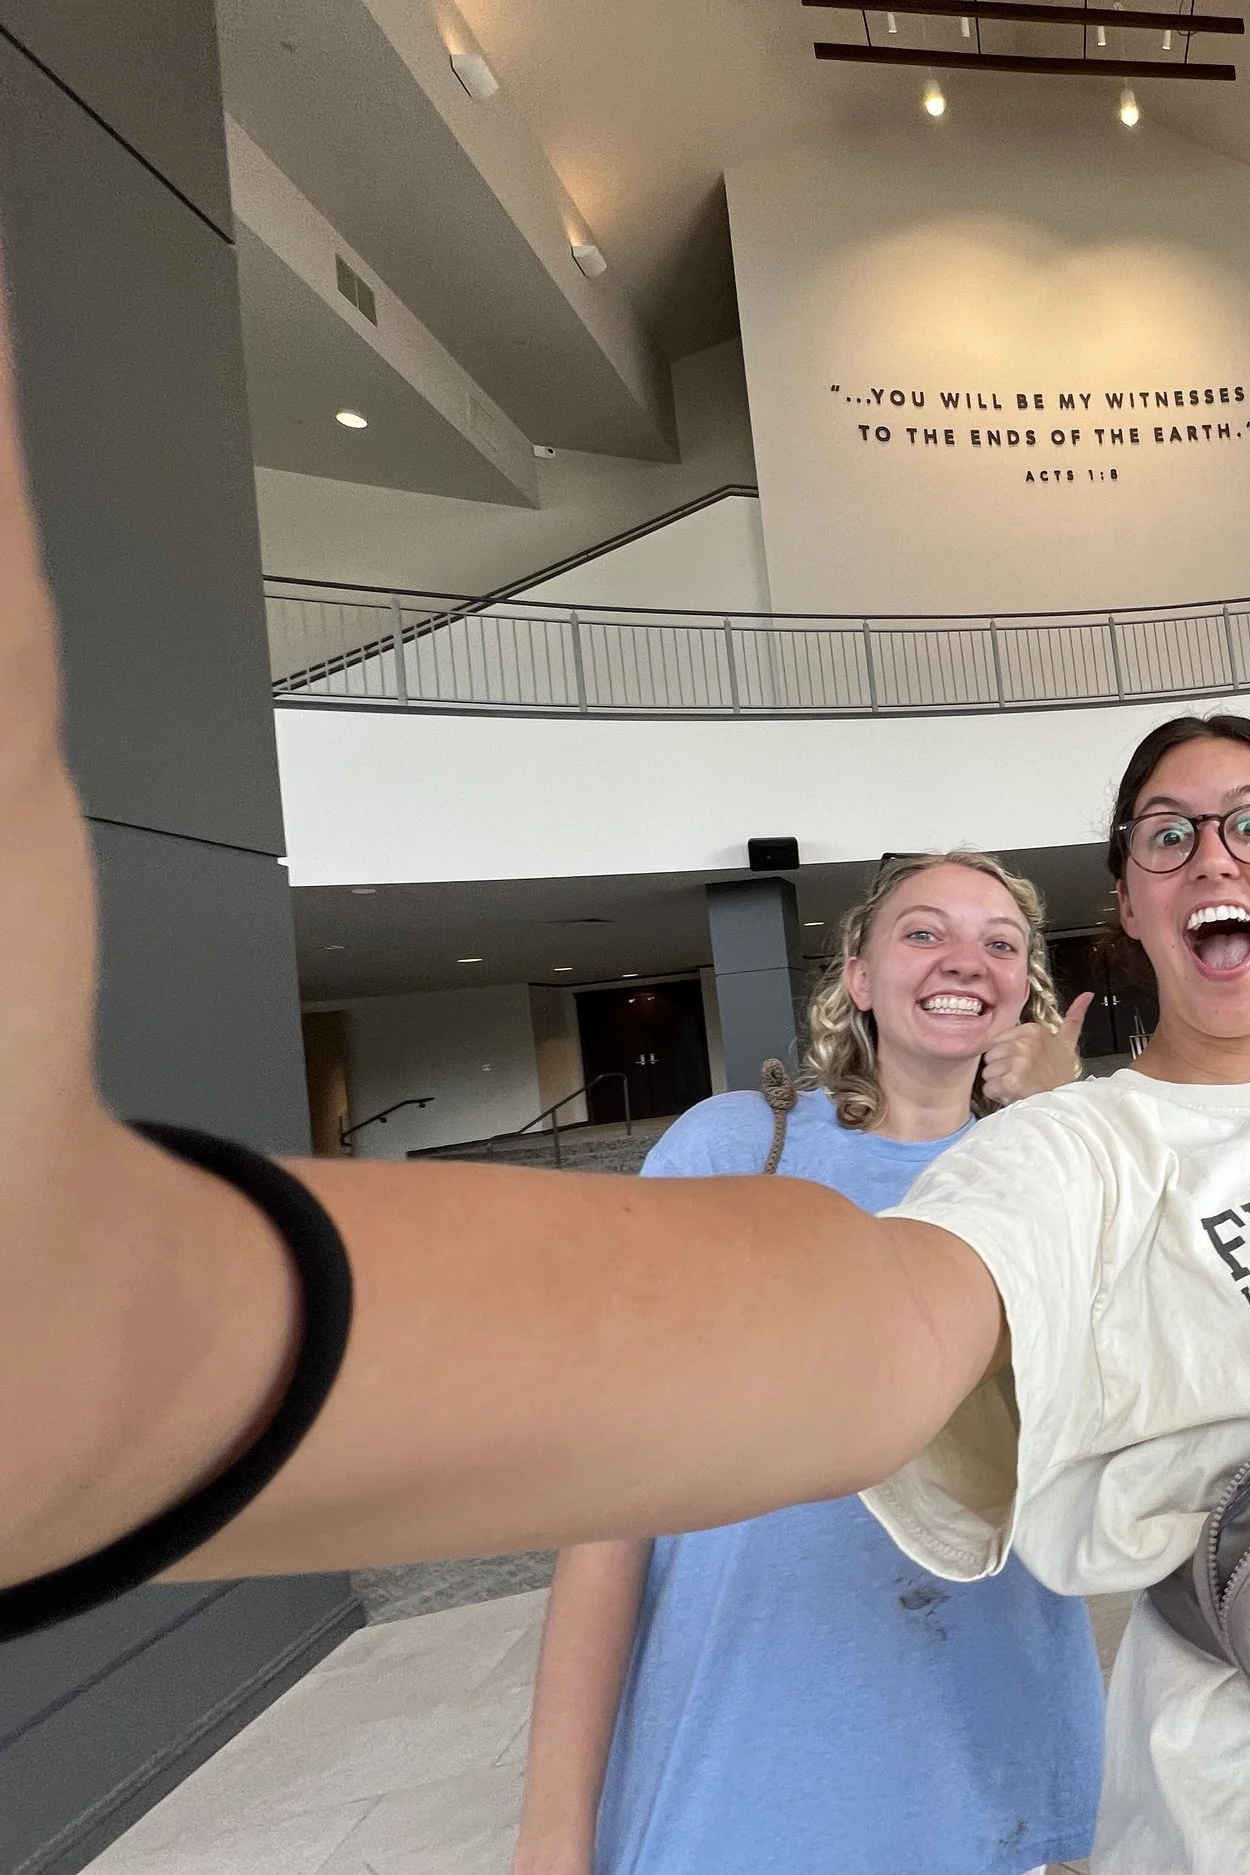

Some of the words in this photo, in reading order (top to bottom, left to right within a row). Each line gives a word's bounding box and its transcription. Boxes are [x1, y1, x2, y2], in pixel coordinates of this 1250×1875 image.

[939, 392, 1002, 410] WILL
[1016, 393, 1045, 410] BE
[1059, 392, 1092, 410] MY
[857, 424, 891, 443] TO
[905, 427, 955, 445] THE
[970, 429, 1036, 446] ENDS
[1050, 429, 1081, 446] OF
[1094, 427, 1140, 445] THE
[1025, 469, 1074, 482] ACTS
[1088, 468, 1119, 481] 1:8
